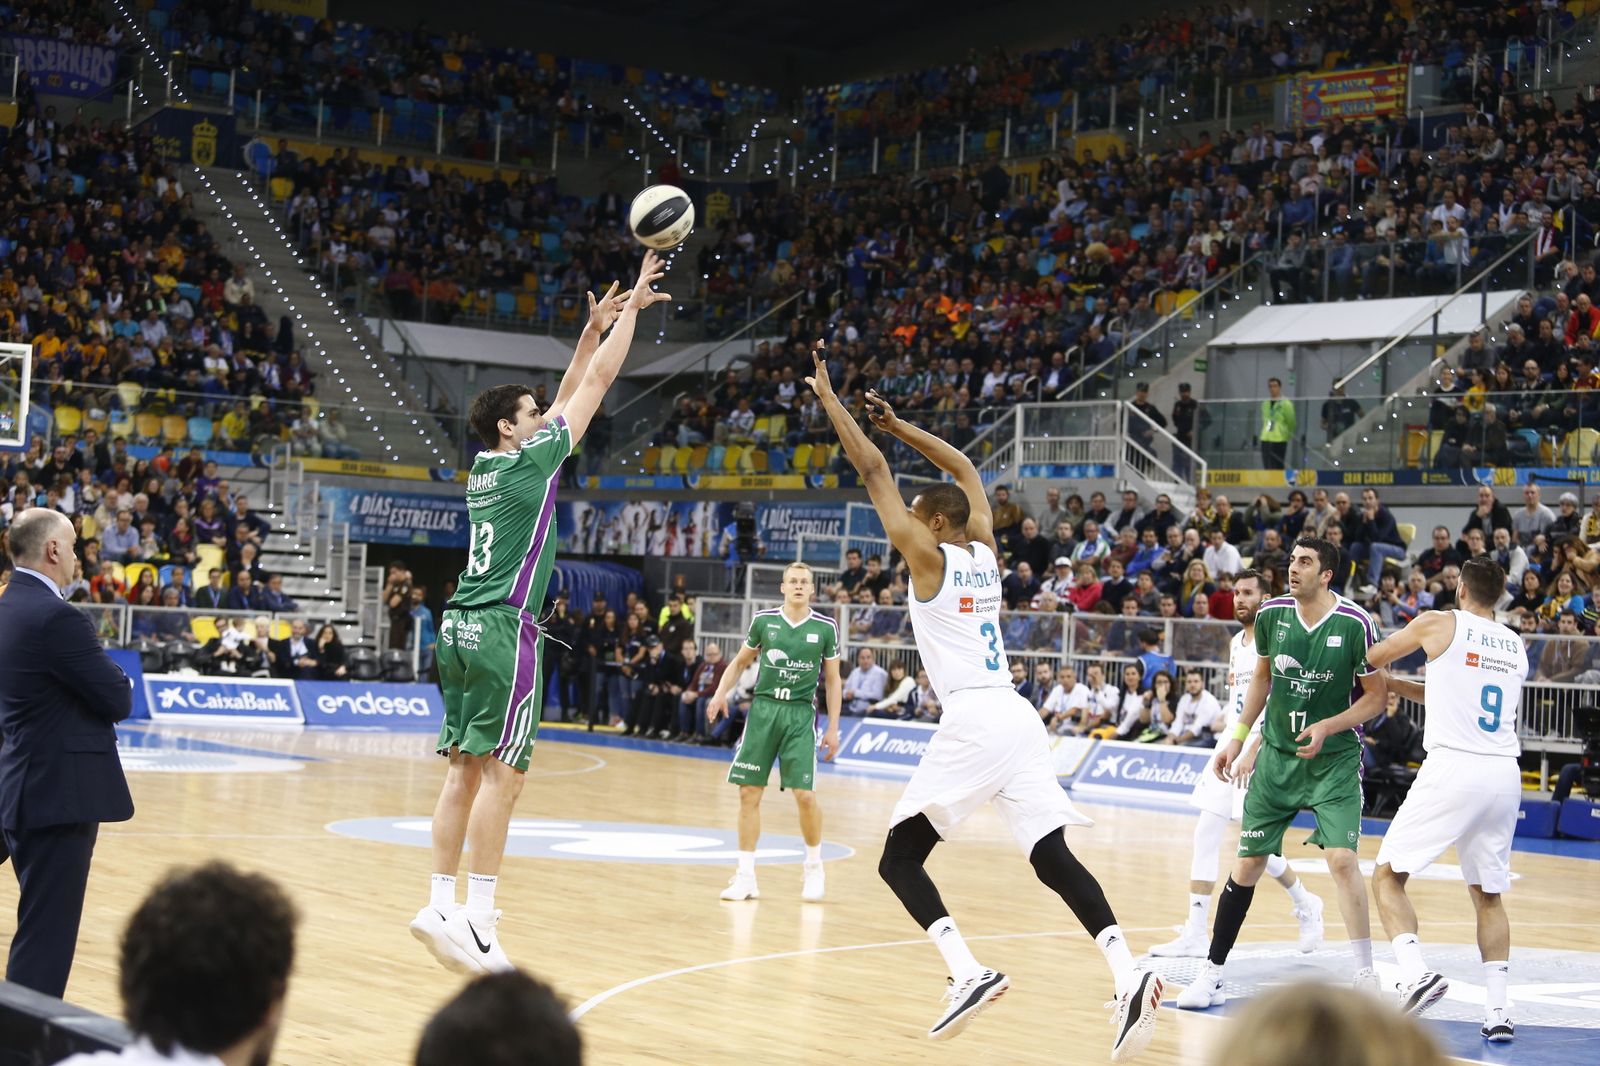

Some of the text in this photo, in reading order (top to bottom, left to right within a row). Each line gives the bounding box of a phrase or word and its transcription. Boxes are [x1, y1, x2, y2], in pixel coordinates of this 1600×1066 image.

[349, 492, 393, 516] 4 DÍAS
[389, 508, 458, 531] ESTRELLAS
[980, 622, 1000, 671] 3
[1481, 633, 1519, 654] REYES
[1481, 655, 1518, 671] Universidad
[1481, 663, 1509, 675] Europea
[188, 688, 291, 712] CaixaBank
[317, 691, 431, 717] endesa
[773, 687, 791, 701] 10
[1235, 693, 1244, 714] 5
[1478, 685, 1503, 733] 9
[1288, 710, 1307, 733] 17
[734, 761, 761, 772] worten
